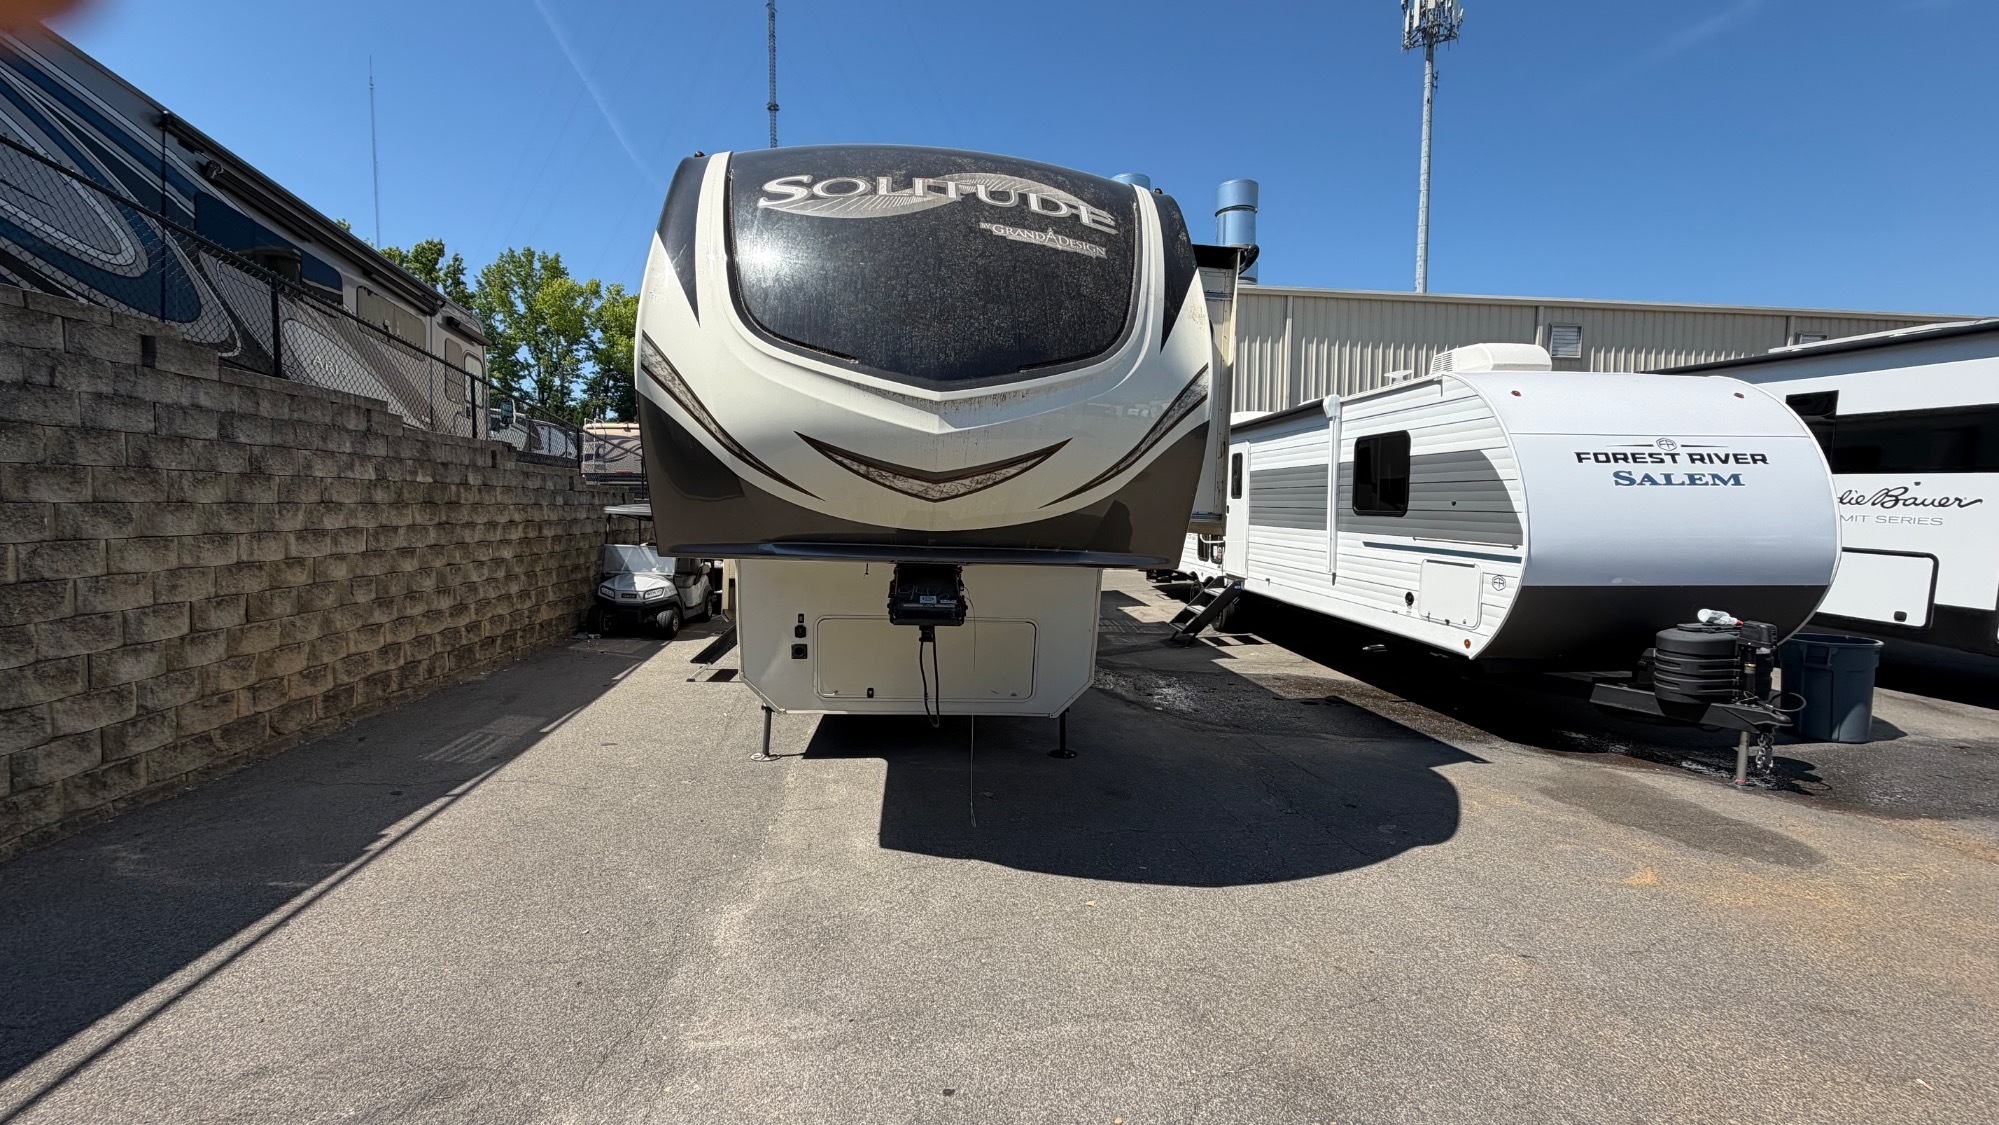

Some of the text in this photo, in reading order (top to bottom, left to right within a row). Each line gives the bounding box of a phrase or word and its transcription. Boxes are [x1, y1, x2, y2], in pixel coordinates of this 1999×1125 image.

[757, 175, 1119, 234] SOLITUDE
[992, 224, 1046, 241] GRAND
[1058, 236, 1107, 255] DESIGN
[1574, 452, 1770, 465] FOREST RIVER
[1612, 470, 1746, 487] SALEM
[1868, 486, 1983, 510] Bauer
[1875, 515, 1944, 526] SERIES
